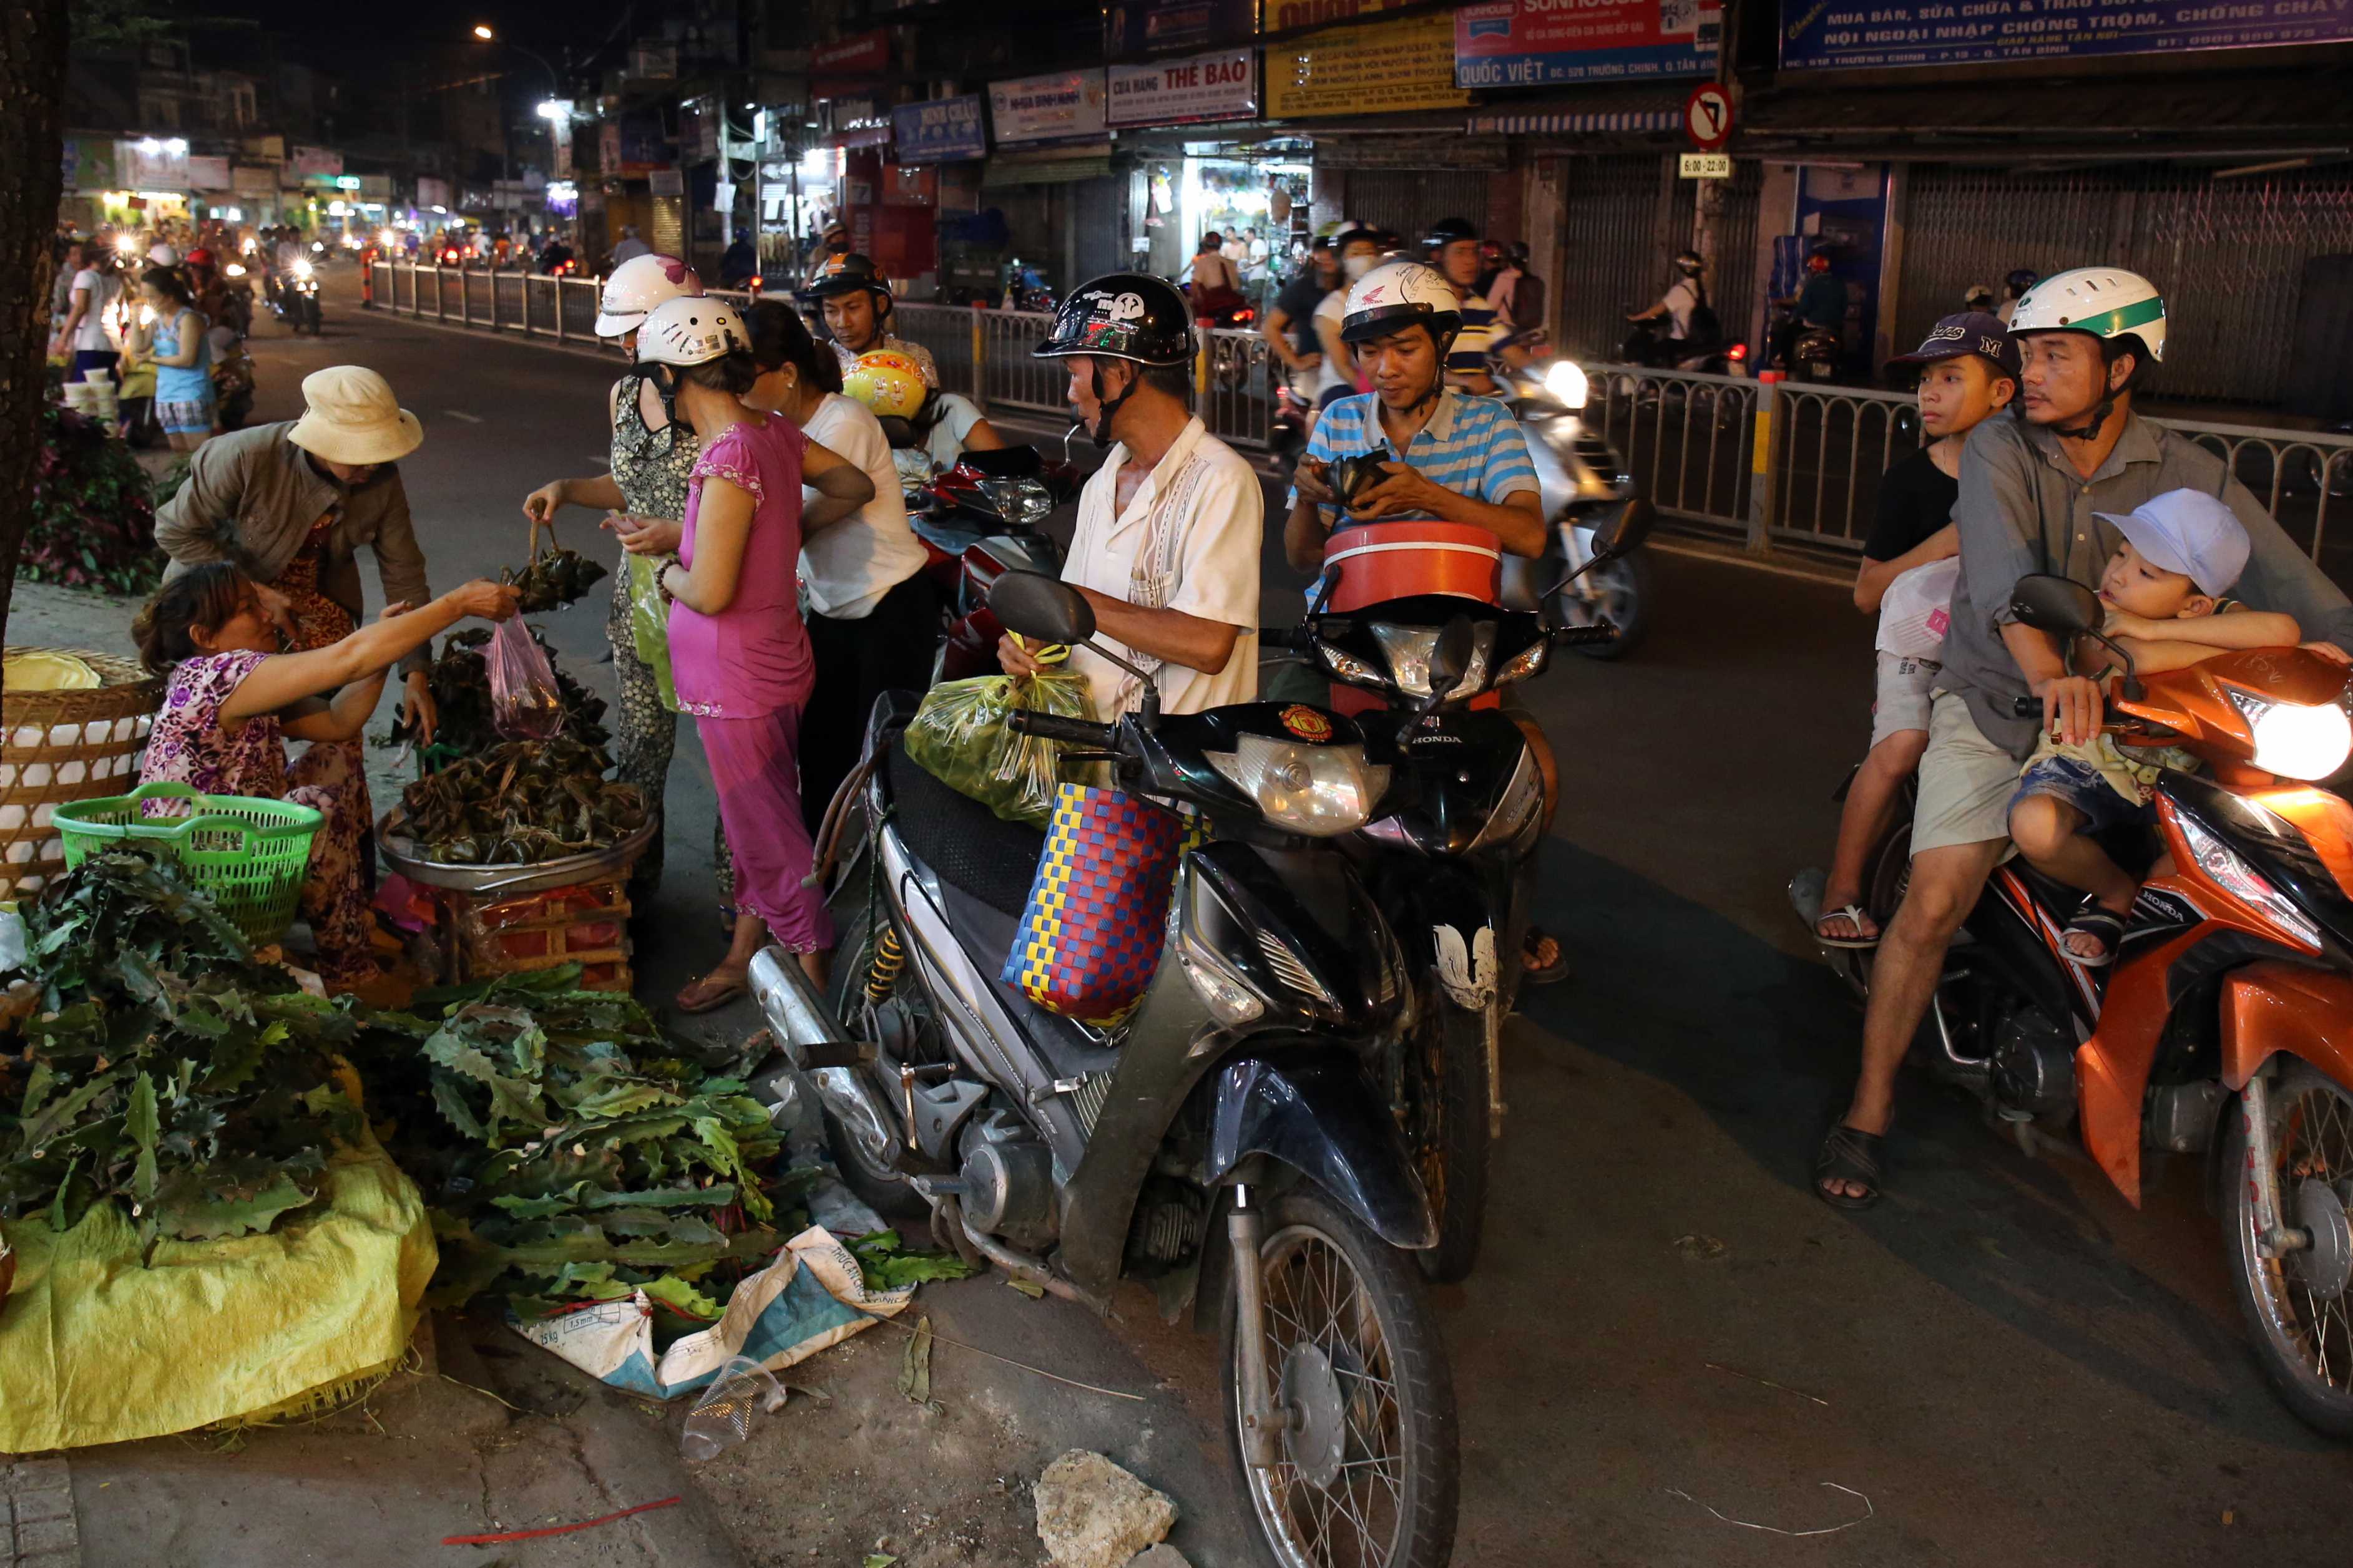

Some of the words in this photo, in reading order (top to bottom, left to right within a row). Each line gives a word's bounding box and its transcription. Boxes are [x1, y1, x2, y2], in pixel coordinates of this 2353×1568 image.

[1824, 31, 1861, 46] NỘI
[1864, 27, 1929, 43] NGOẠI
[1935, 22, 1995, 39] NHẬP
[2002, 16, 2078, 34] CHỐNG
[2175, 4, 2265, 23] CHỐNG
[1827, 12, 1866, 26] MUA
[1460, 57, 1502, 84] QUỐC
[1507, 57, 1544, 85] VIỆT
[1685, 160, 1701, 172] 6:00
[1707, 160, 1726, 172] 22:00
[1979, 336, 2002, 358] M
[1412, 735, 1464, 745] HONDA
[2142, 890, 2184, 923] HONDA
[969, 1008, 991, 1040] STROKE
[991, 1039, 1025, 1089] TECHNOLOGY
